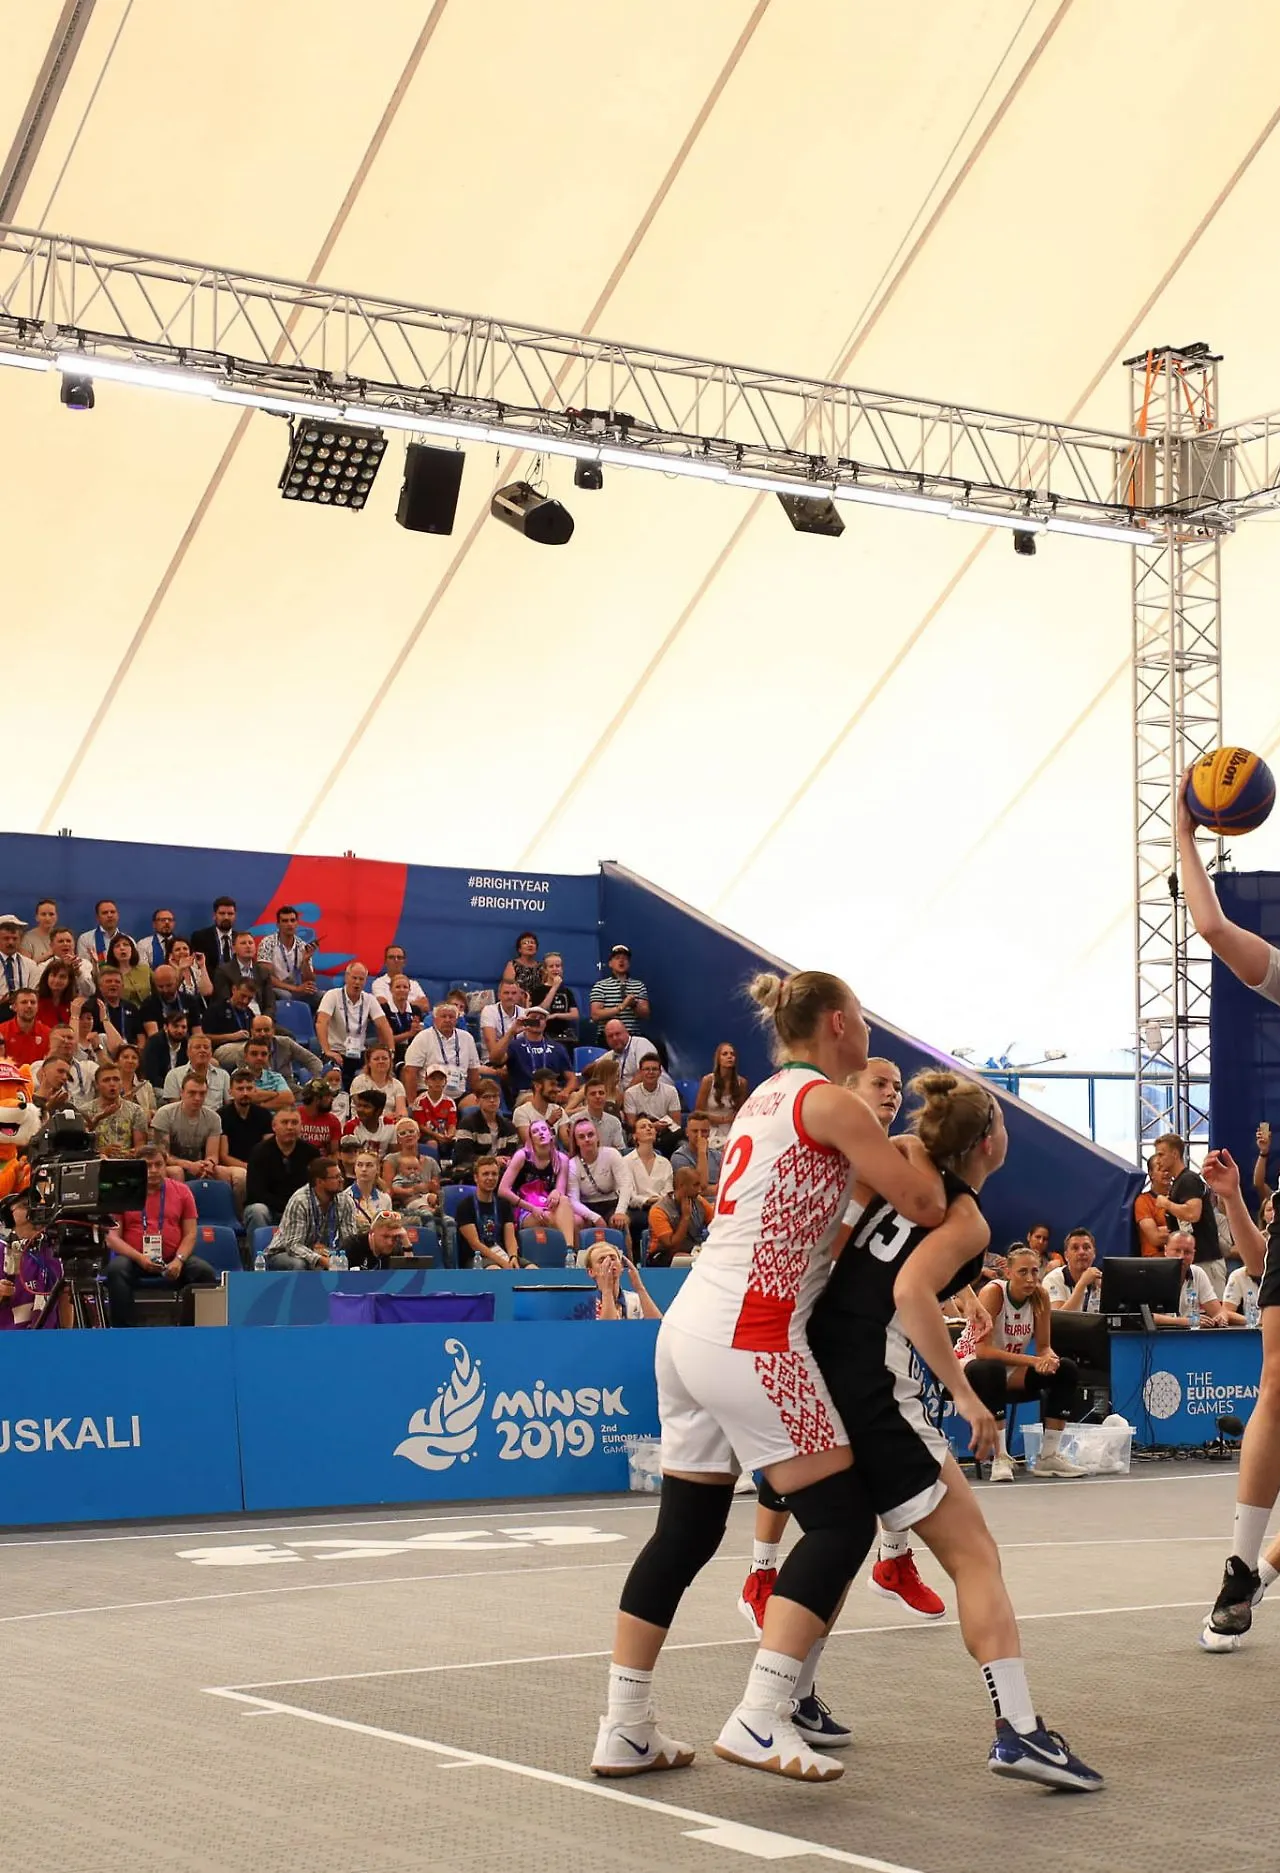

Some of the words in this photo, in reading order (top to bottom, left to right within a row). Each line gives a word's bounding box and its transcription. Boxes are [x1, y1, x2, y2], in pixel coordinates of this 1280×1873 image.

[467, 876, 550, 893] #BRIGHTYEAR
[470, 896, 546, 912] #BRIGHTYOU
[717, 1135, 753, 1215] 2
[853, 1203, 918, 1263] 13
[1186, 1372, 1213, 1386] THE
[1186, 1400, 1234, 1415] GAMES
[600, 1424, 618, 1433] 2nd
[495, 1418, 596, 1460] 2019
[603, 1445, 629, 1454] GAME
